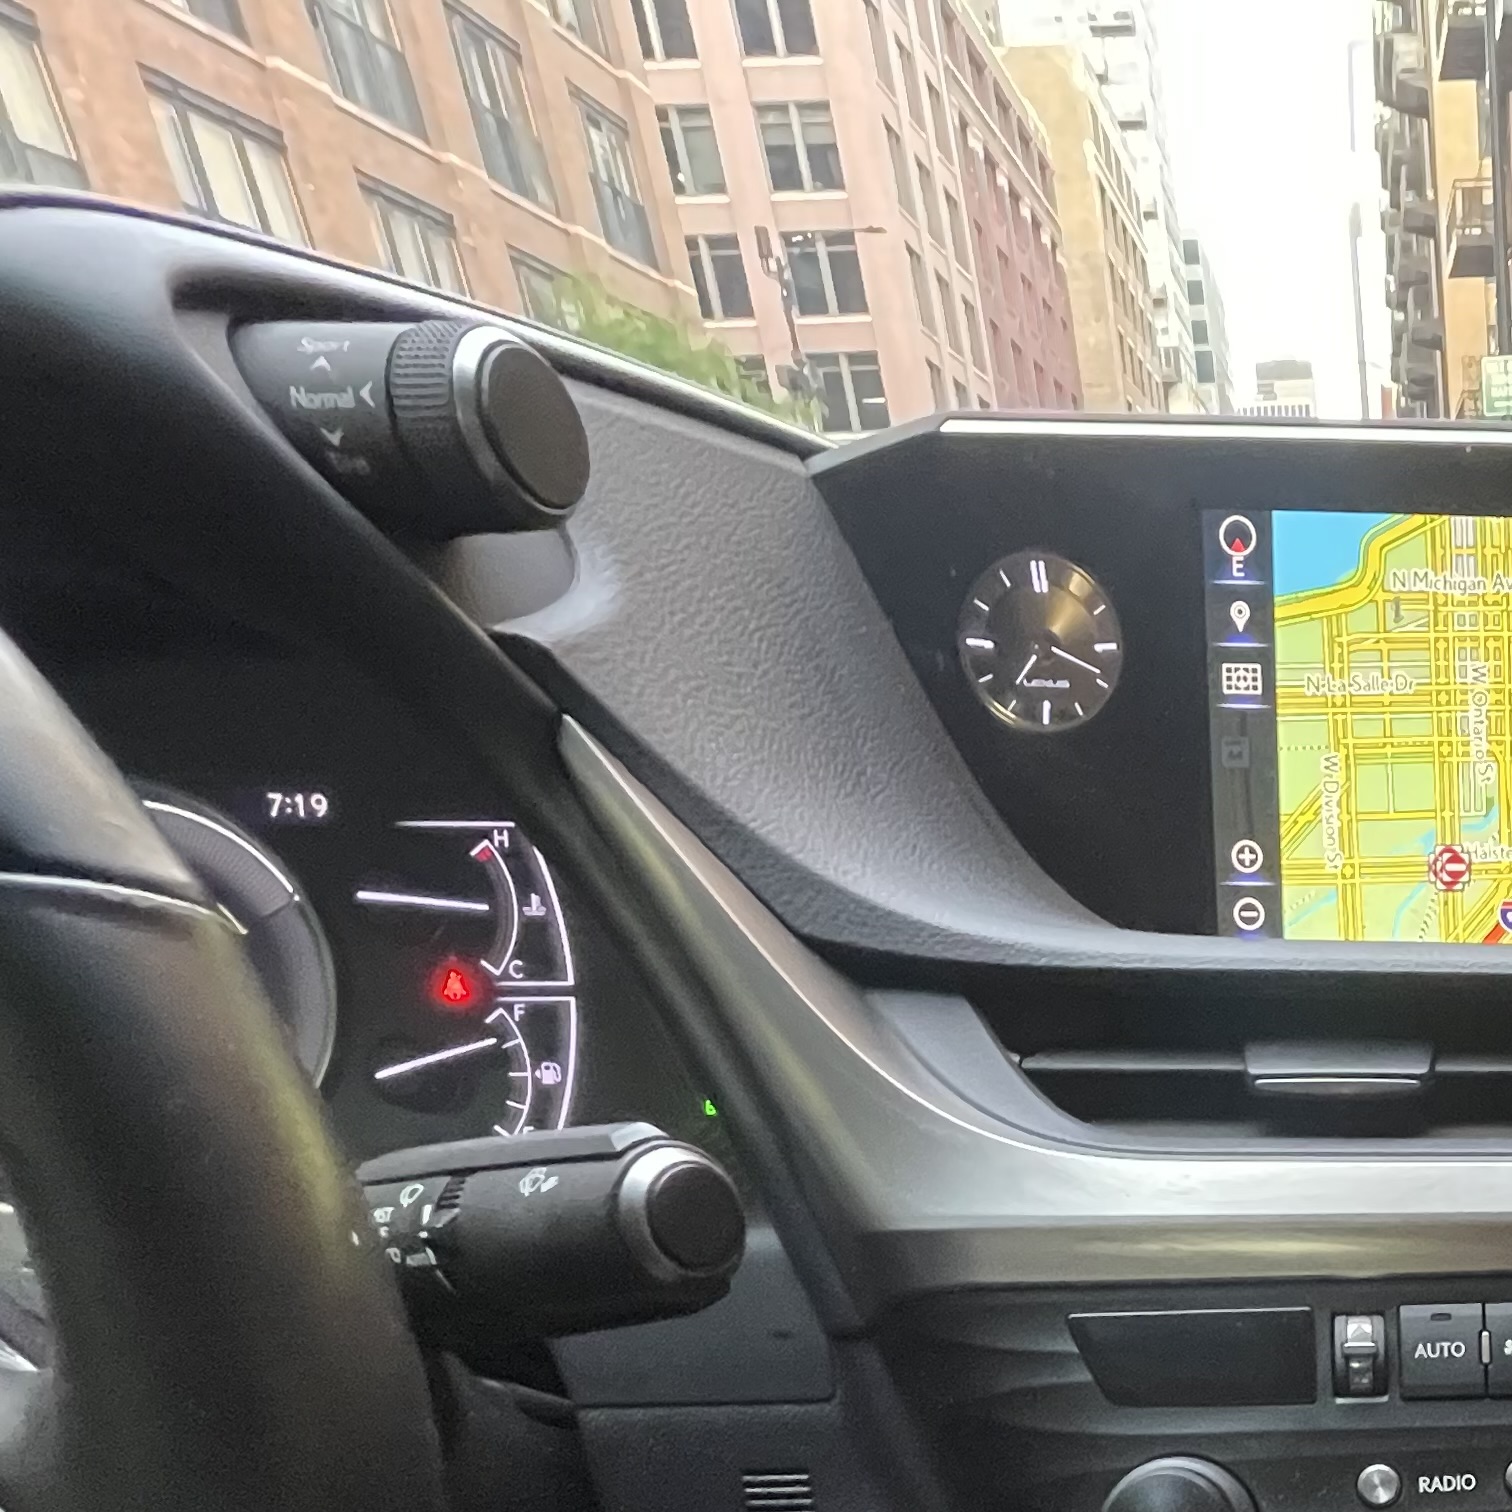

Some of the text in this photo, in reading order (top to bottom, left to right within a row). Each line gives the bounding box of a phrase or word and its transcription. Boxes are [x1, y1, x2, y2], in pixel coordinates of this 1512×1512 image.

[1231, 556, 1245, 577] E
[1392, 571, 1406, 588] N
[1413, 571, 1486, 594] Michigan
[1307, 675, 1414, 692] N La Salle Dr
[1471, 665, 1493, 783] W Ontario St
[266, 791, 328, 818] 7:19
[1323, 755, 1342, 870] W Division St
[493, 829, 509, 848] H
[508, 960, 523, 979] C
[513, 1004, 525, 1022] F
[1414, 1341, 1466, 1359] AUTO
[1418, 1474, 1477, 1493] RADIO
